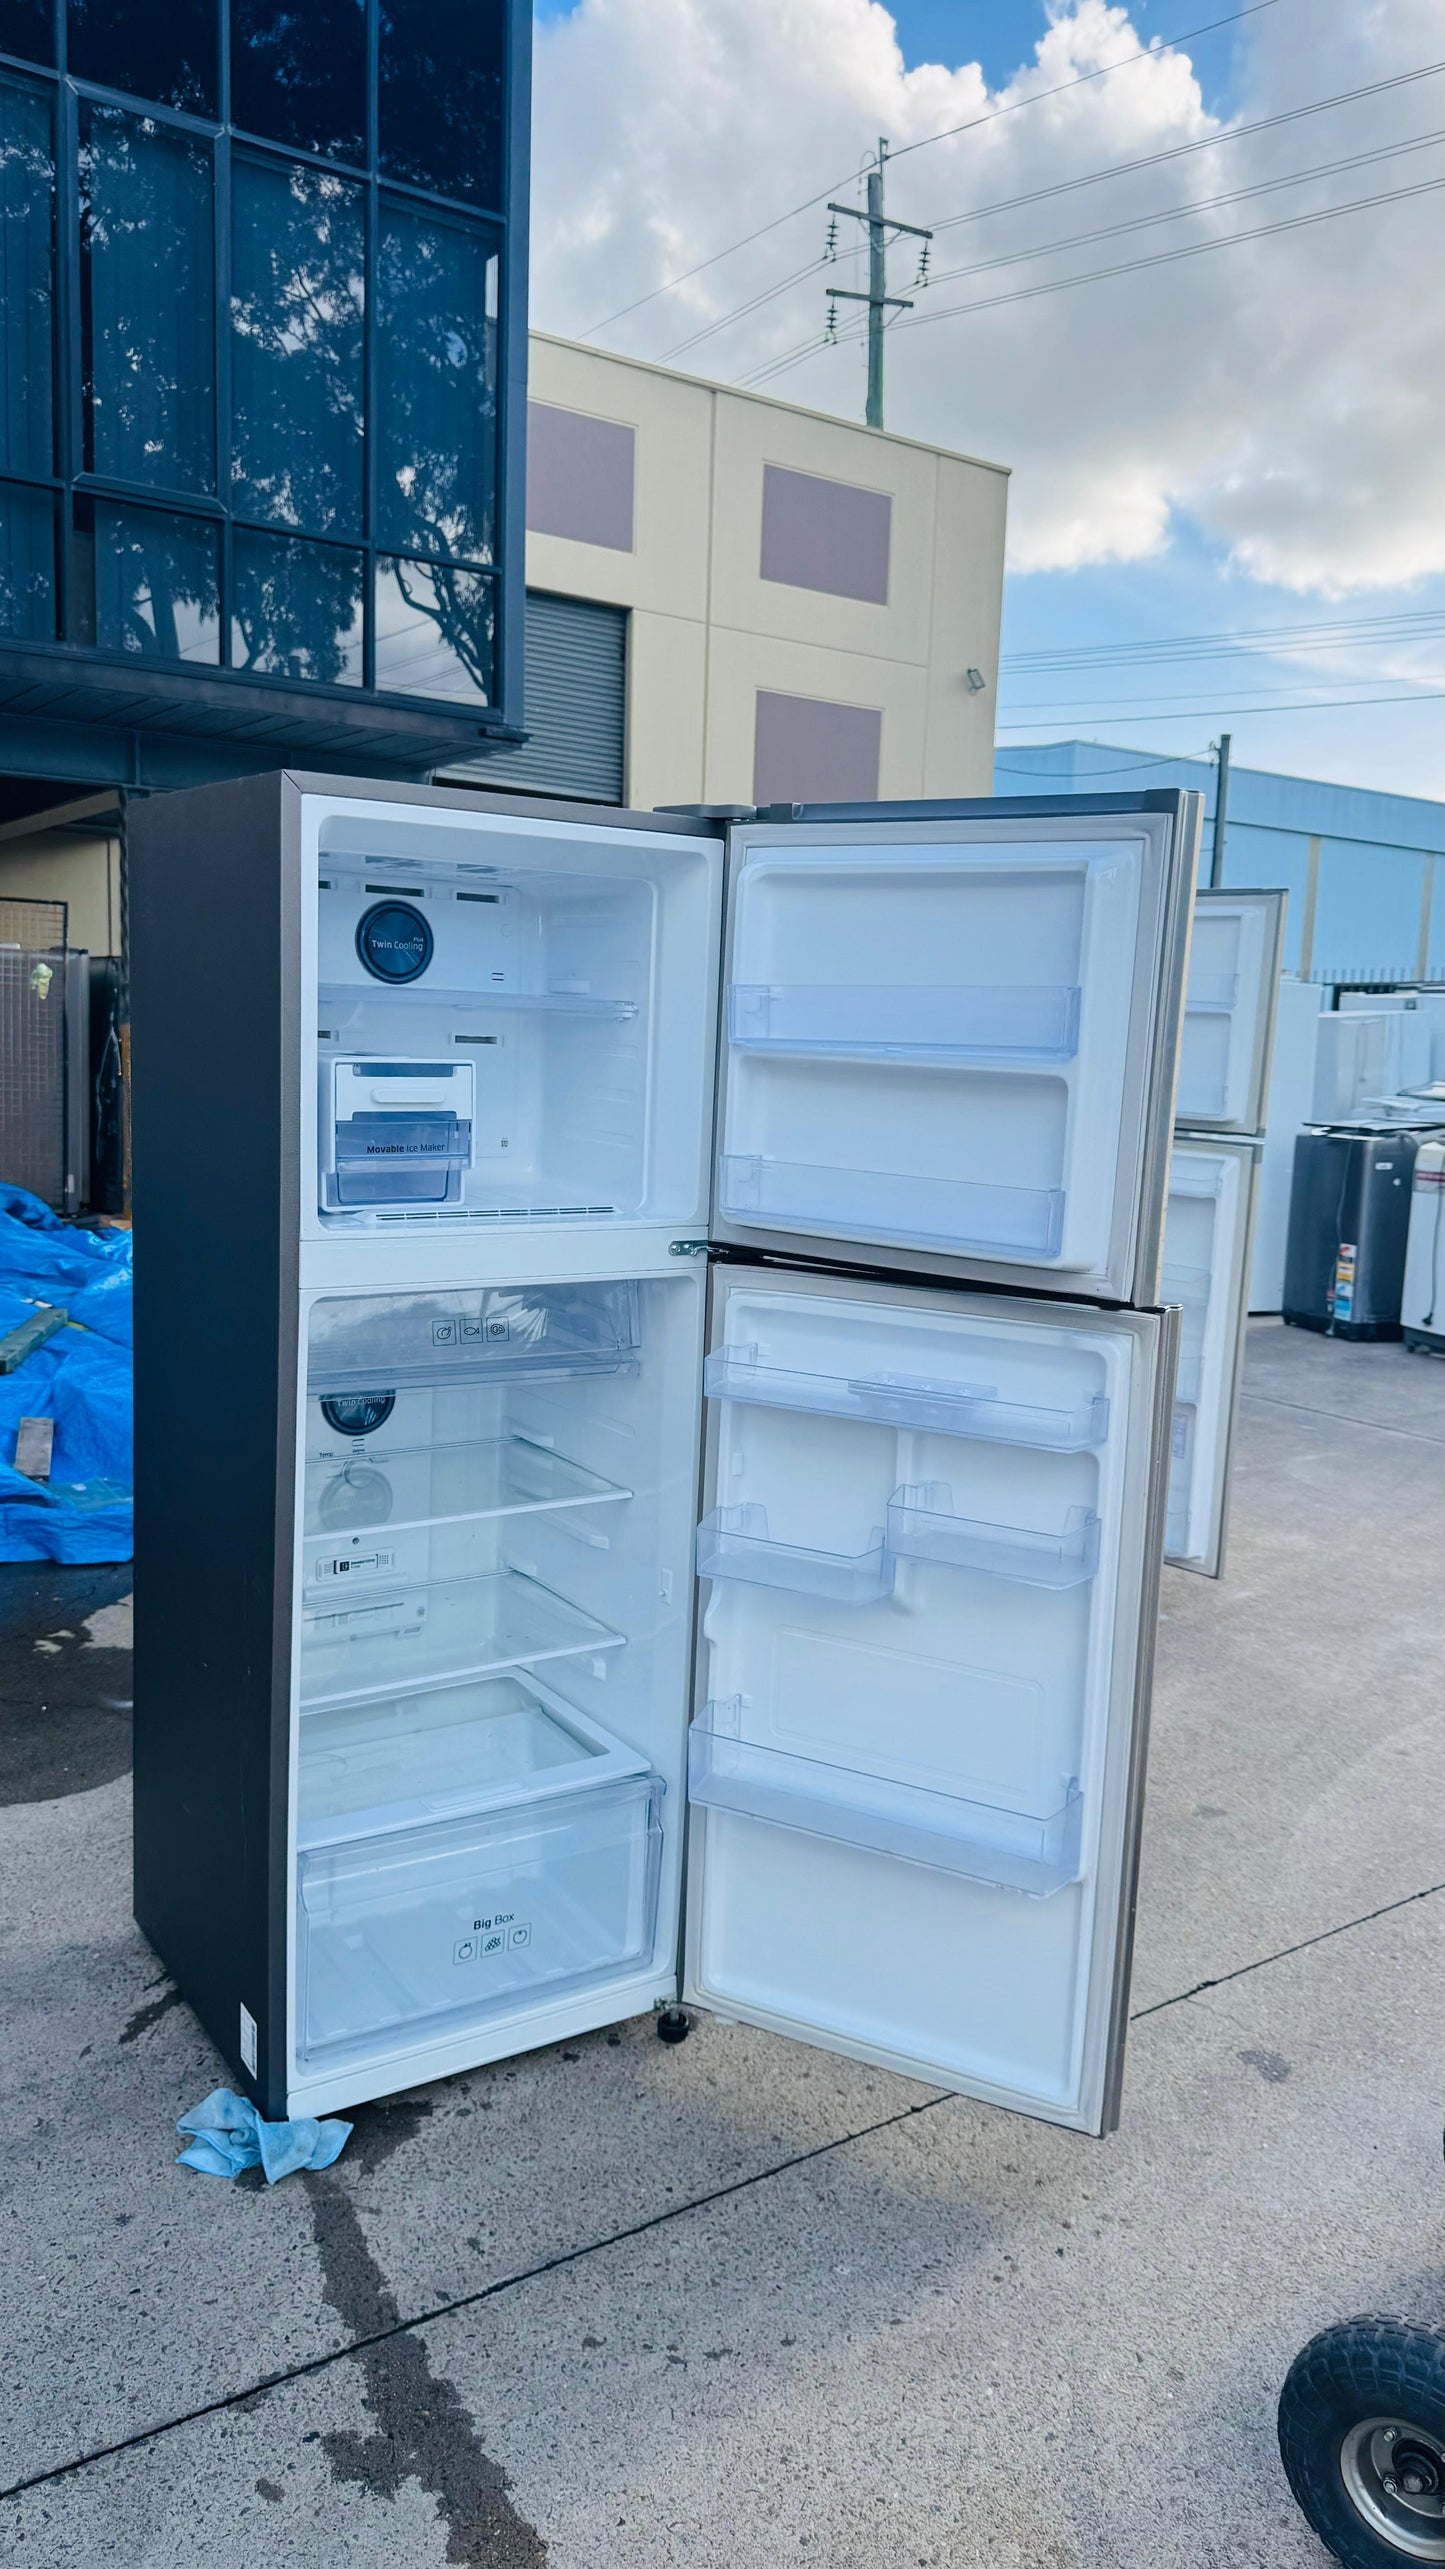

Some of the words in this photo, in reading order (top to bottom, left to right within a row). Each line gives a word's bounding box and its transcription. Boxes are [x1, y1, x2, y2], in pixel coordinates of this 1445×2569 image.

[371, 939, 393, 949] Twin
[394, 941, 423, 952] Cooling
[367, 1145, 404, 1154] Movable
[407, 1144, 418, 1152] Ice
[420, 1143, 445, 1152] Maker
[473, 1918, 492, 1930] Big
[494, 1913, 515, 1925] Box
